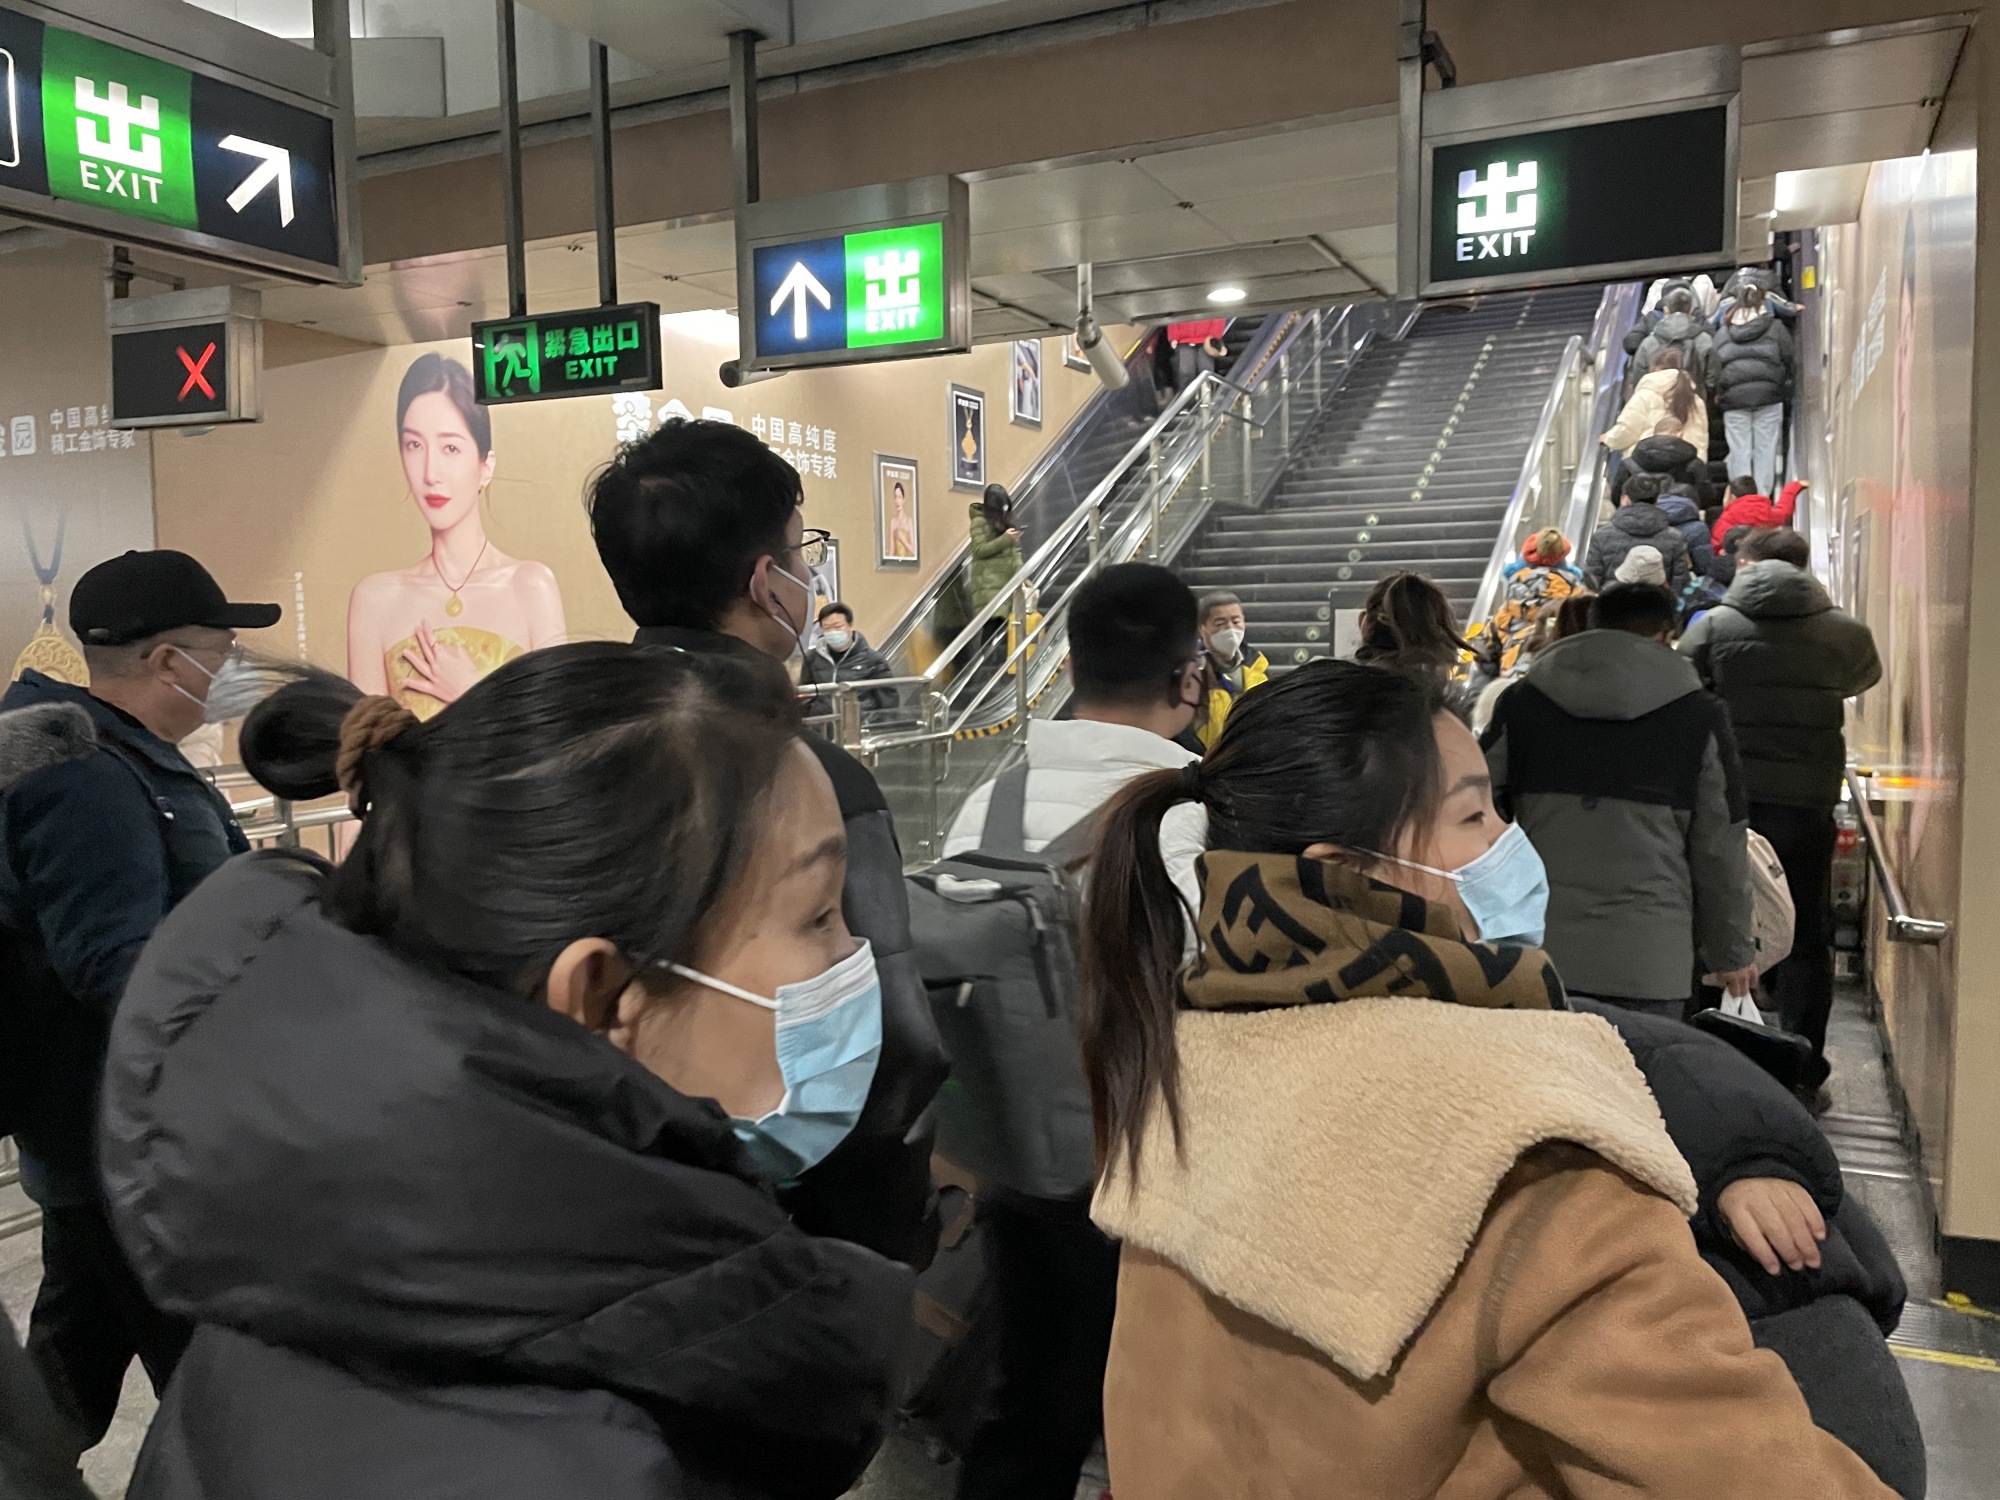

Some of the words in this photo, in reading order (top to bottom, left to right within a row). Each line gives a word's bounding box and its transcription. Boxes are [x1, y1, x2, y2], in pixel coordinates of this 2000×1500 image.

[75, 76, 162, 173] 出
[80, 160, 163, 203] EXIT
[1457, 161, 1537, 235] 出
[1456, 229, 1536, 262] EXIT
[864, 250, 920, 312] 出
[865, 306, 920, 333] EXIT
[566, 355, 619, 380] EXIT
[0, 414, 37, 458] 园
[751, 413, 837, 453] 中国高纯度
